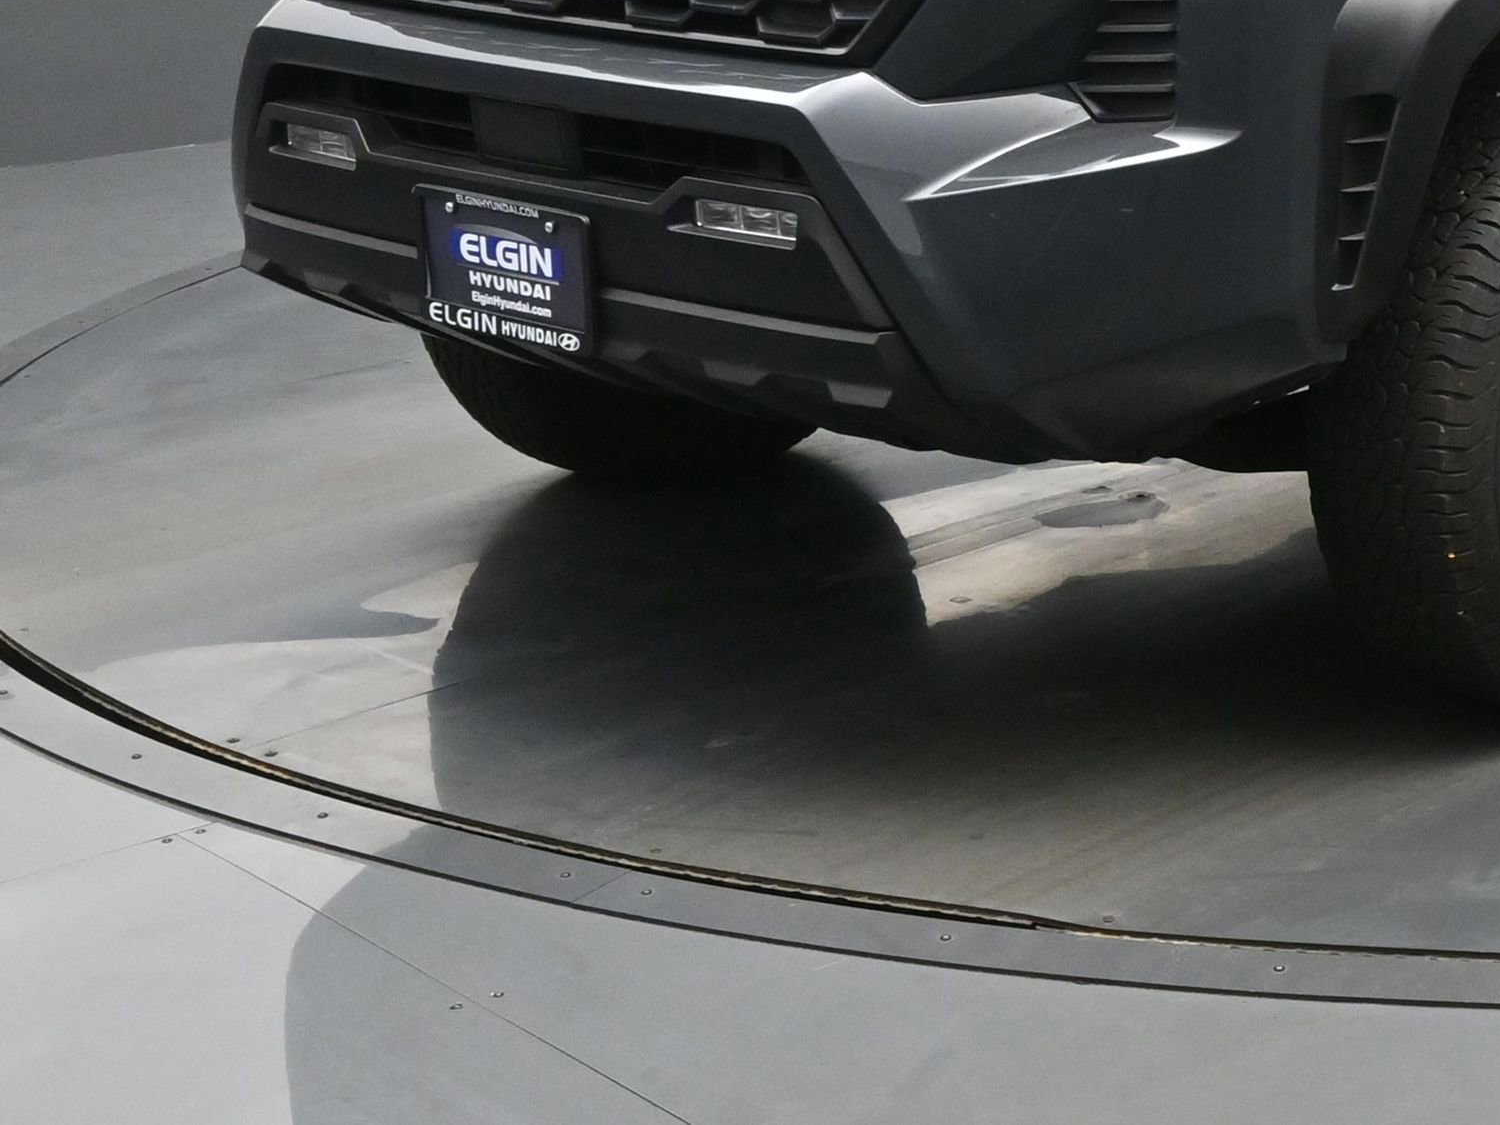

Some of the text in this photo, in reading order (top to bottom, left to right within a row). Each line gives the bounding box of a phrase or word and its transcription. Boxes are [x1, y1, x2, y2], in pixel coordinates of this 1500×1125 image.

[455, 193, 539, 219] ELGINHYUNDAI.COM
[459, 232, 553, 278] ELGIN
[468, 270, 551, 301] HYUNDAI
[471, 290, 552, 318] ElginHyundai.com
[428, 301, 557, 347] ELGIN HYUNDAI
